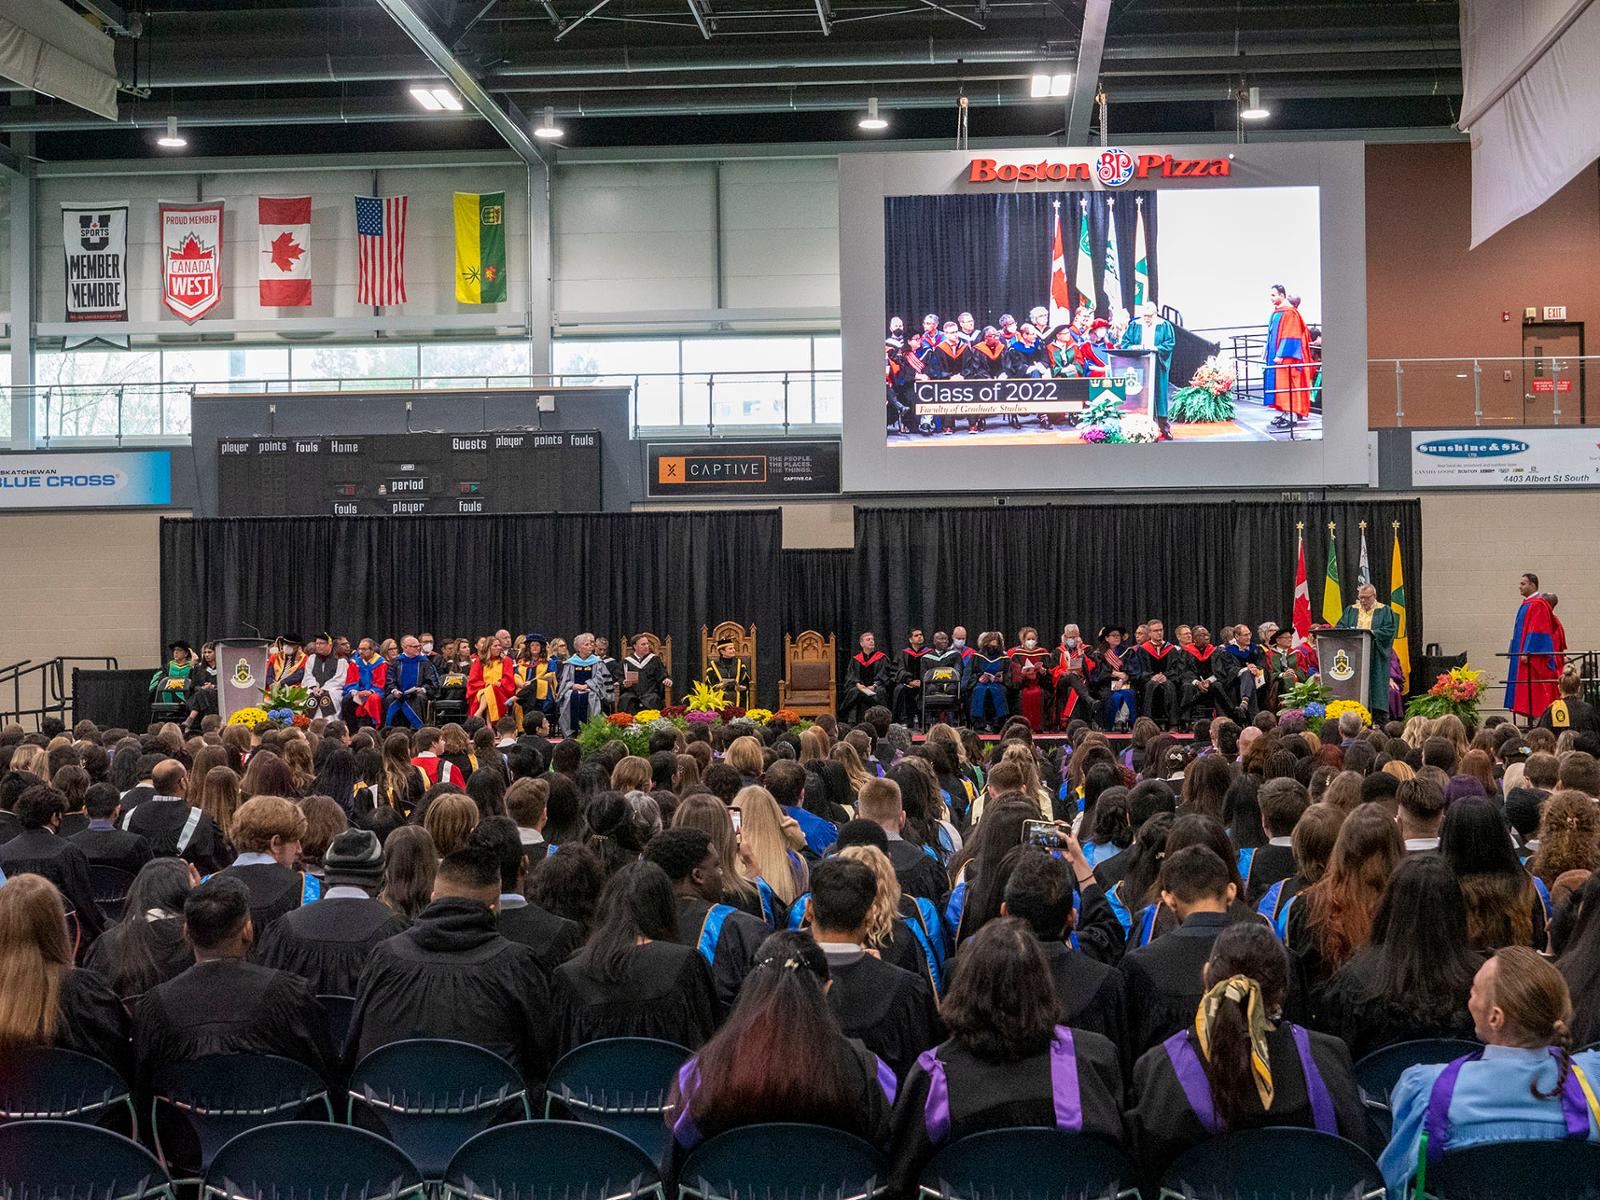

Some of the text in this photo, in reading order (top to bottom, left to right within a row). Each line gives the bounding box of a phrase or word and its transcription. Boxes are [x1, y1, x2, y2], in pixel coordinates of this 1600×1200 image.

[968, 158, 1090, 182] Boston
[1136, 154, 1230, 178] Pizza
[166, 215, 217, 225] PROUD MEMBER
[81, 228, 109, 237] SPORTS
[70, 254, 120, 279] MEMBER
[171, 260, 212, 274] CANADA
[171, 276, 212, 296] WEST
[1548, 308, 1562, 320] EXIT
[918, 382, 1058, 402] Class of 2022
[920, 404, 949, 415] Faculty
[960, 404, 997, 413] Graduate
[1000, 404, 1028, 413] Studies
[221, 441, 358, 455] player points fouls Home
[452, 434, 594, 450] Guests player points fouls
[1419, 442, 1487, 453] Sunshine
[1488, 441, 1501, 451] &
[690, 463, 759, 476] CAPTIVE
[46, 475, 116, 487] CROSS
[1503, 474, 1590, 483] 4403 Albert St South
[392, 479, 424, 492] period
[334, 501, 482, 515] fouls player fouls
